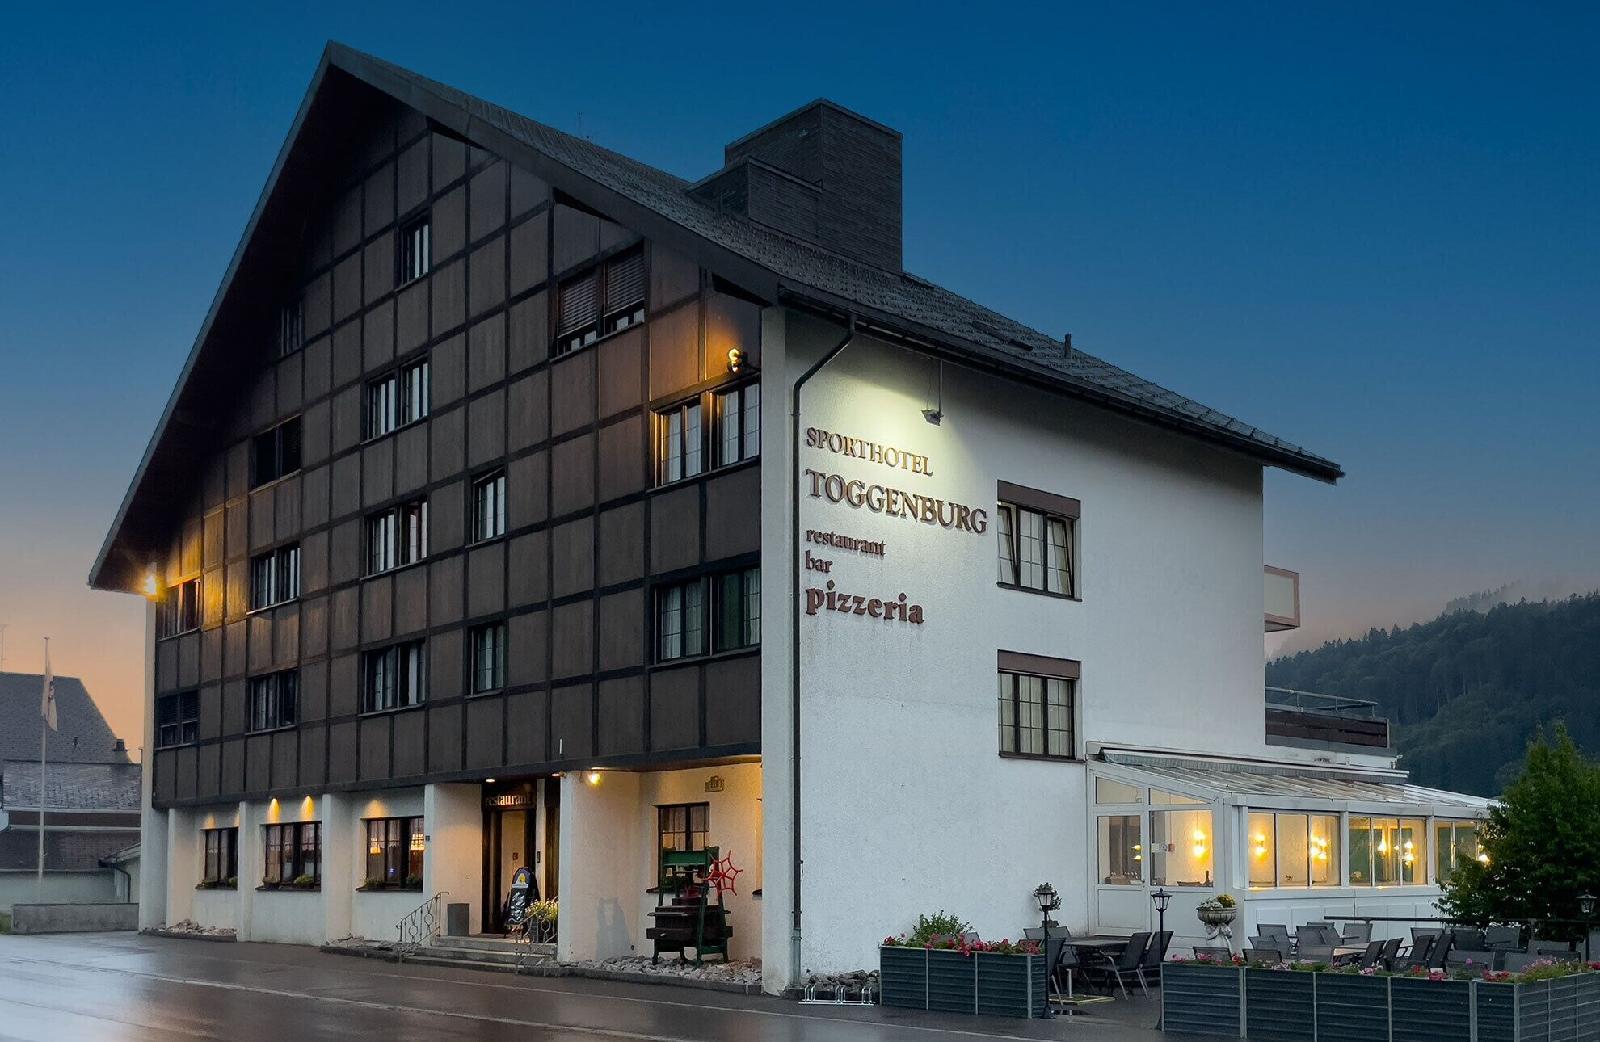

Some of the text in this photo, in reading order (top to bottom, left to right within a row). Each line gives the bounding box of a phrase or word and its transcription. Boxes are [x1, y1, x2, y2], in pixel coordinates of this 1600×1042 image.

[806, 427, 933, 477] SPORTHOTEL
[806, 469, 988, 534] TOGGENBURG
[805, 550, 833, 573] bar
[806, 528, 886, 558] restaurant
[805, 579, 925, 624] pizzeria
[486, 794, 531, 806] restauran
